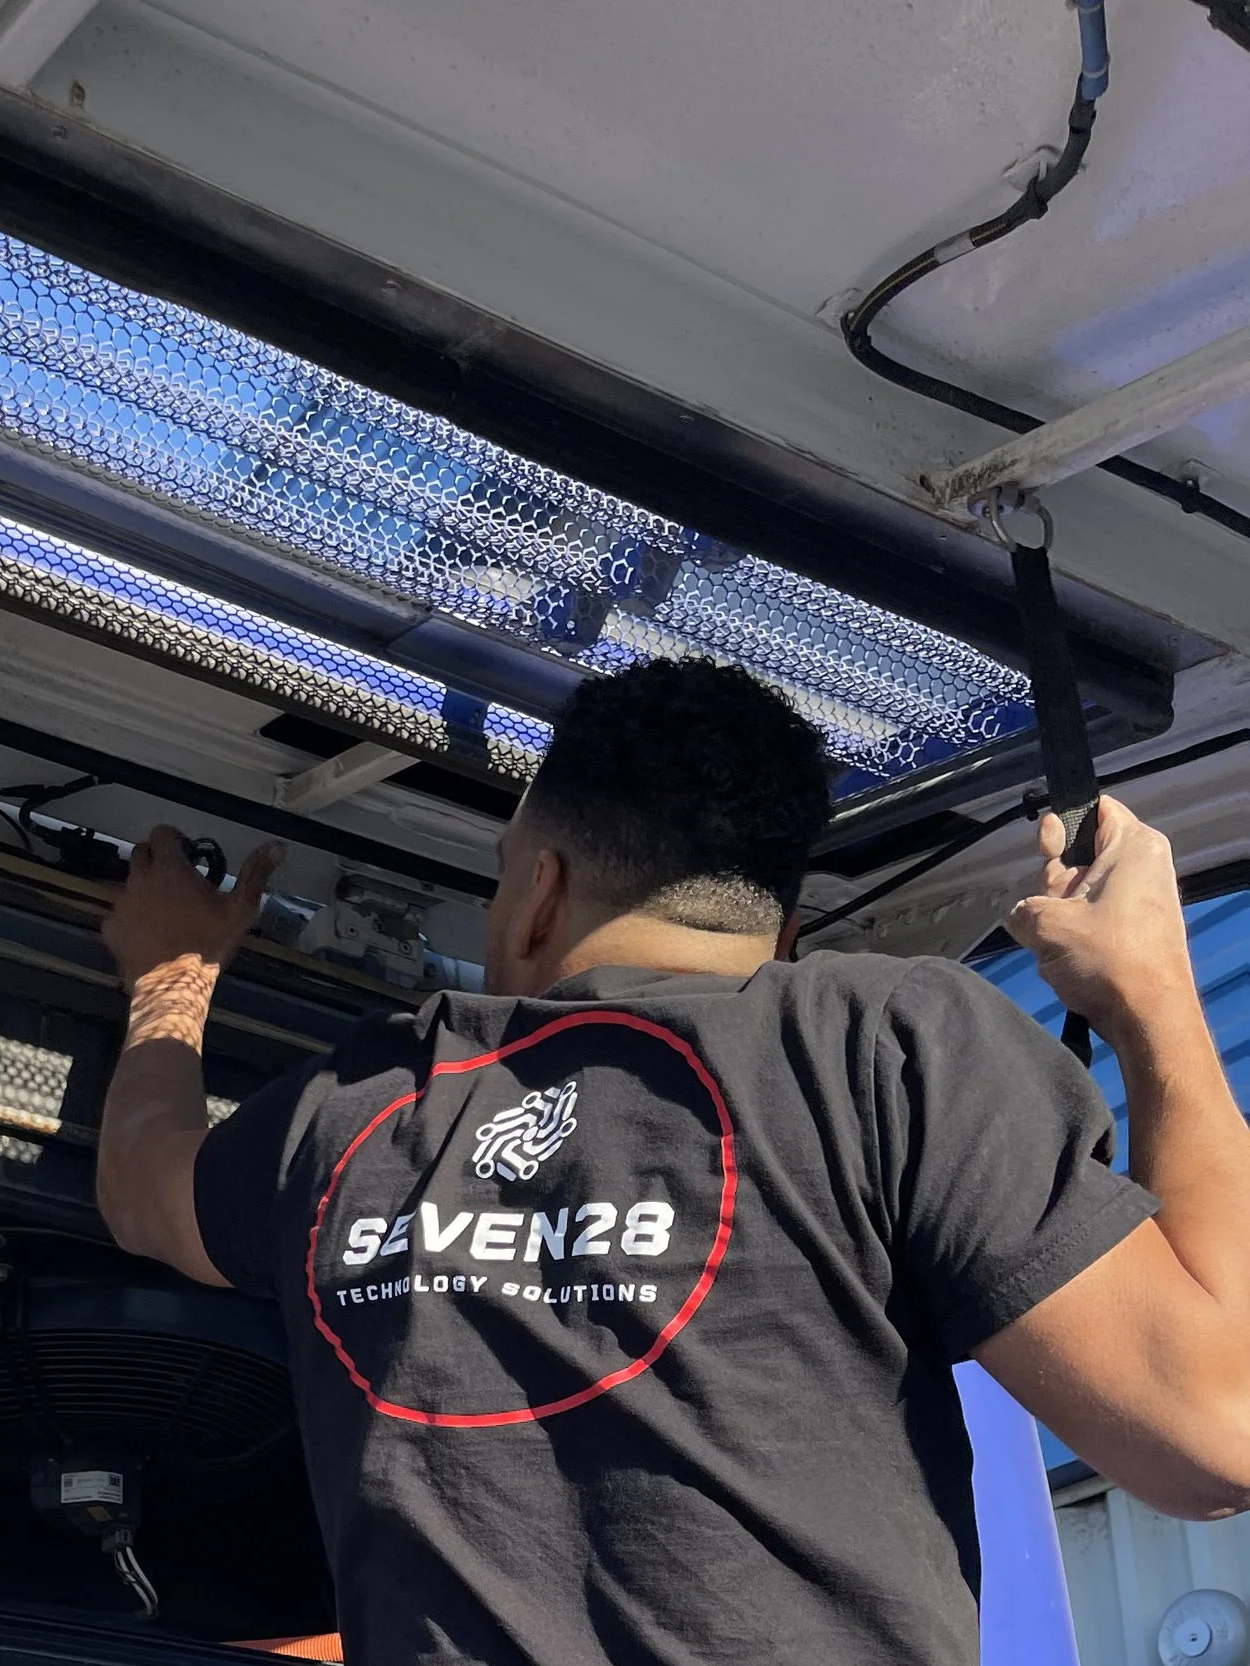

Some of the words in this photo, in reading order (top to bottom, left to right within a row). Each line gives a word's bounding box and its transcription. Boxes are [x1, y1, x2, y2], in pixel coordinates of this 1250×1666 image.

[342, 1201, 675, 1265] SEVEN28
[336, 1274, 488, 1306] TECHNOLOGY
[502, 1281, 658, 1305] SOLUTIONS
